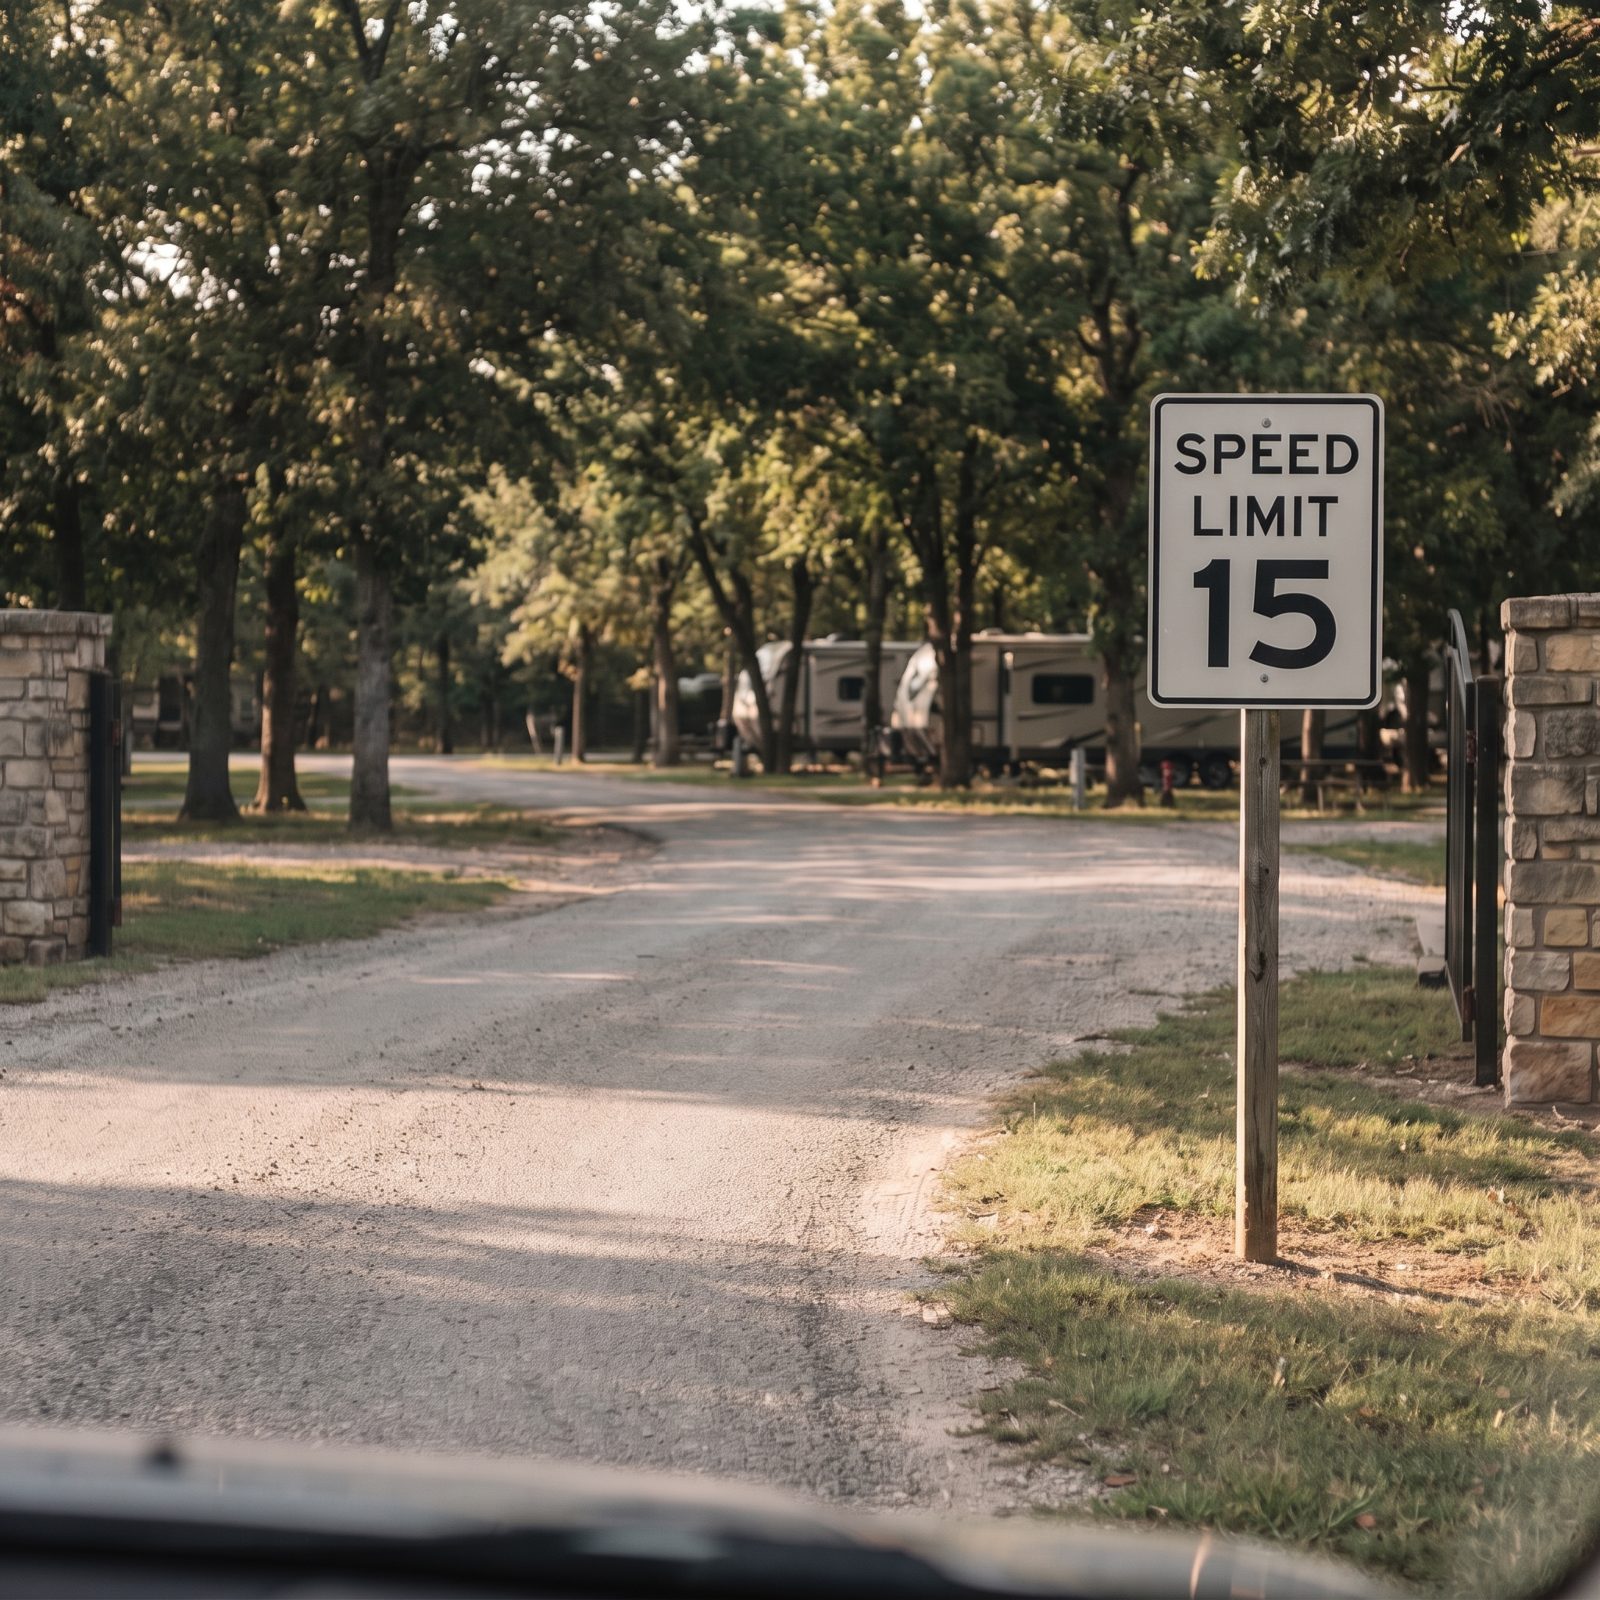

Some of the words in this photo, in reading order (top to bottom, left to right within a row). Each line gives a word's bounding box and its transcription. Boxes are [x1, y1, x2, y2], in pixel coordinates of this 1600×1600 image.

[1174, 433, 1359, 475] SPEED
[1193, 495, 1339, 537] LIMIT
[1193, 558, 1337, 669] 15
